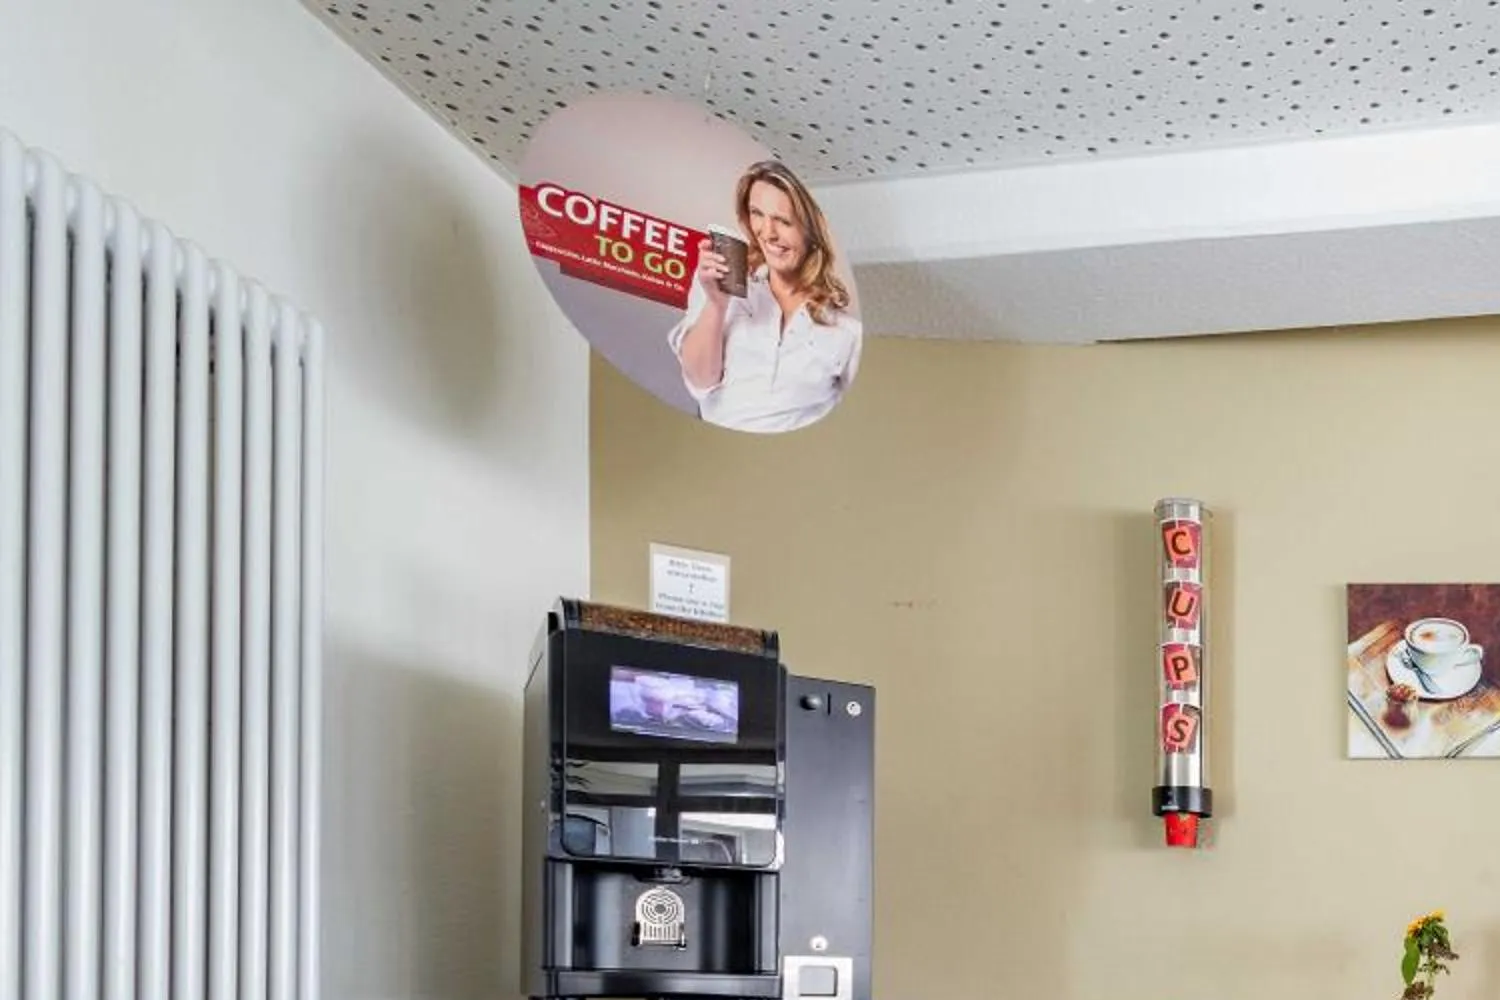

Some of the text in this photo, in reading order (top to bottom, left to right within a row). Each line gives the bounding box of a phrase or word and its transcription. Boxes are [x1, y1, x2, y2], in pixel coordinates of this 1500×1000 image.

[537, 186, 689, 257] COFFEE
[593, 234, 634, 263] TO
[643, 251, 686, 279] GO
